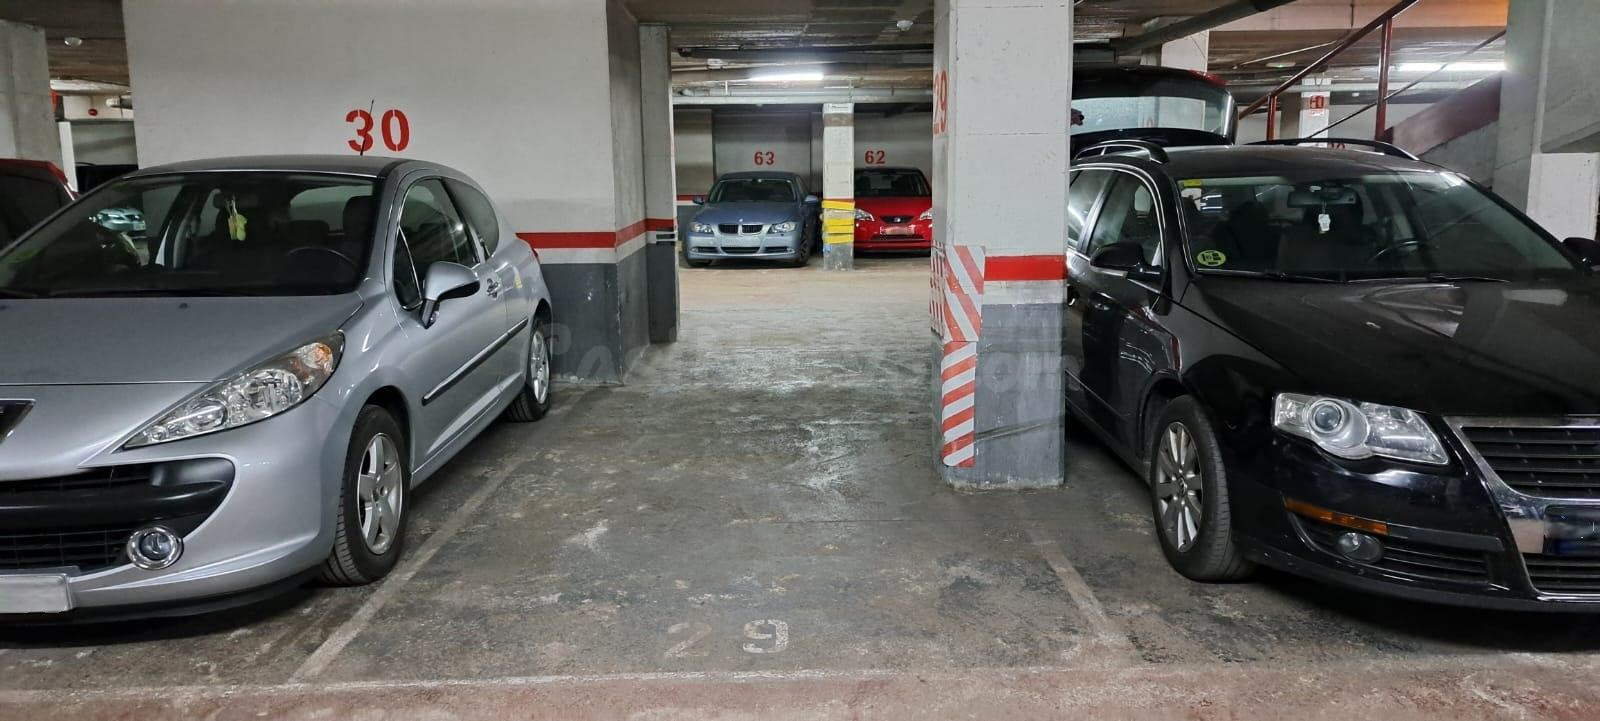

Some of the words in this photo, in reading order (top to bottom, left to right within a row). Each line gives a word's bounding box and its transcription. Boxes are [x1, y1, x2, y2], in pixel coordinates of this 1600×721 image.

[933, 70, 948, 134] 29
[345, 108, 410, 153] 30
[753, 151, 775, 166] 63
[864, 150, 886, 165] 62
